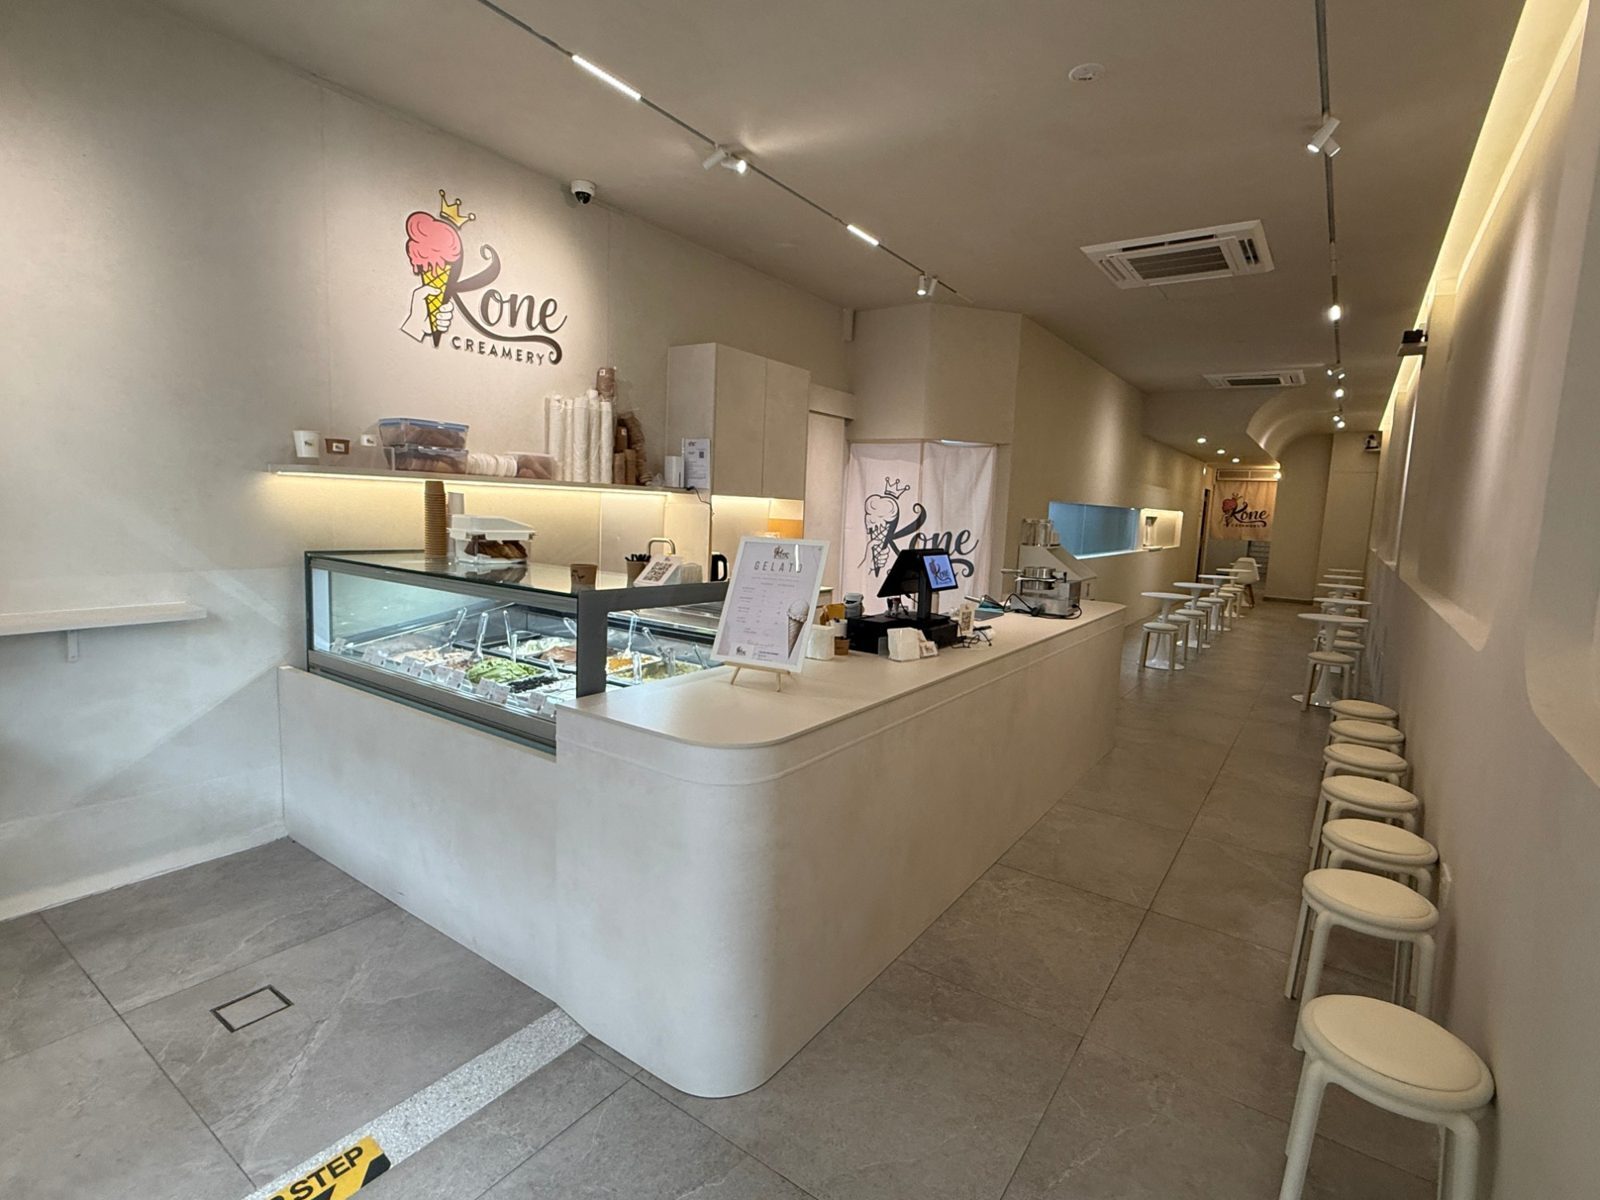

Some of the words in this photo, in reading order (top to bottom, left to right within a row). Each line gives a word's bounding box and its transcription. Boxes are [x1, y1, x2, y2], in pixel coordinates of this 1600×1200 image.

[443, 244, 568, 365] Kone
[451, 336, 545, 366] CREAMERY
[882, 503, 979, 578] Kone
[1230, 501, 1270, 528] Kone
[289, 1146, 364, 1200] STEP
